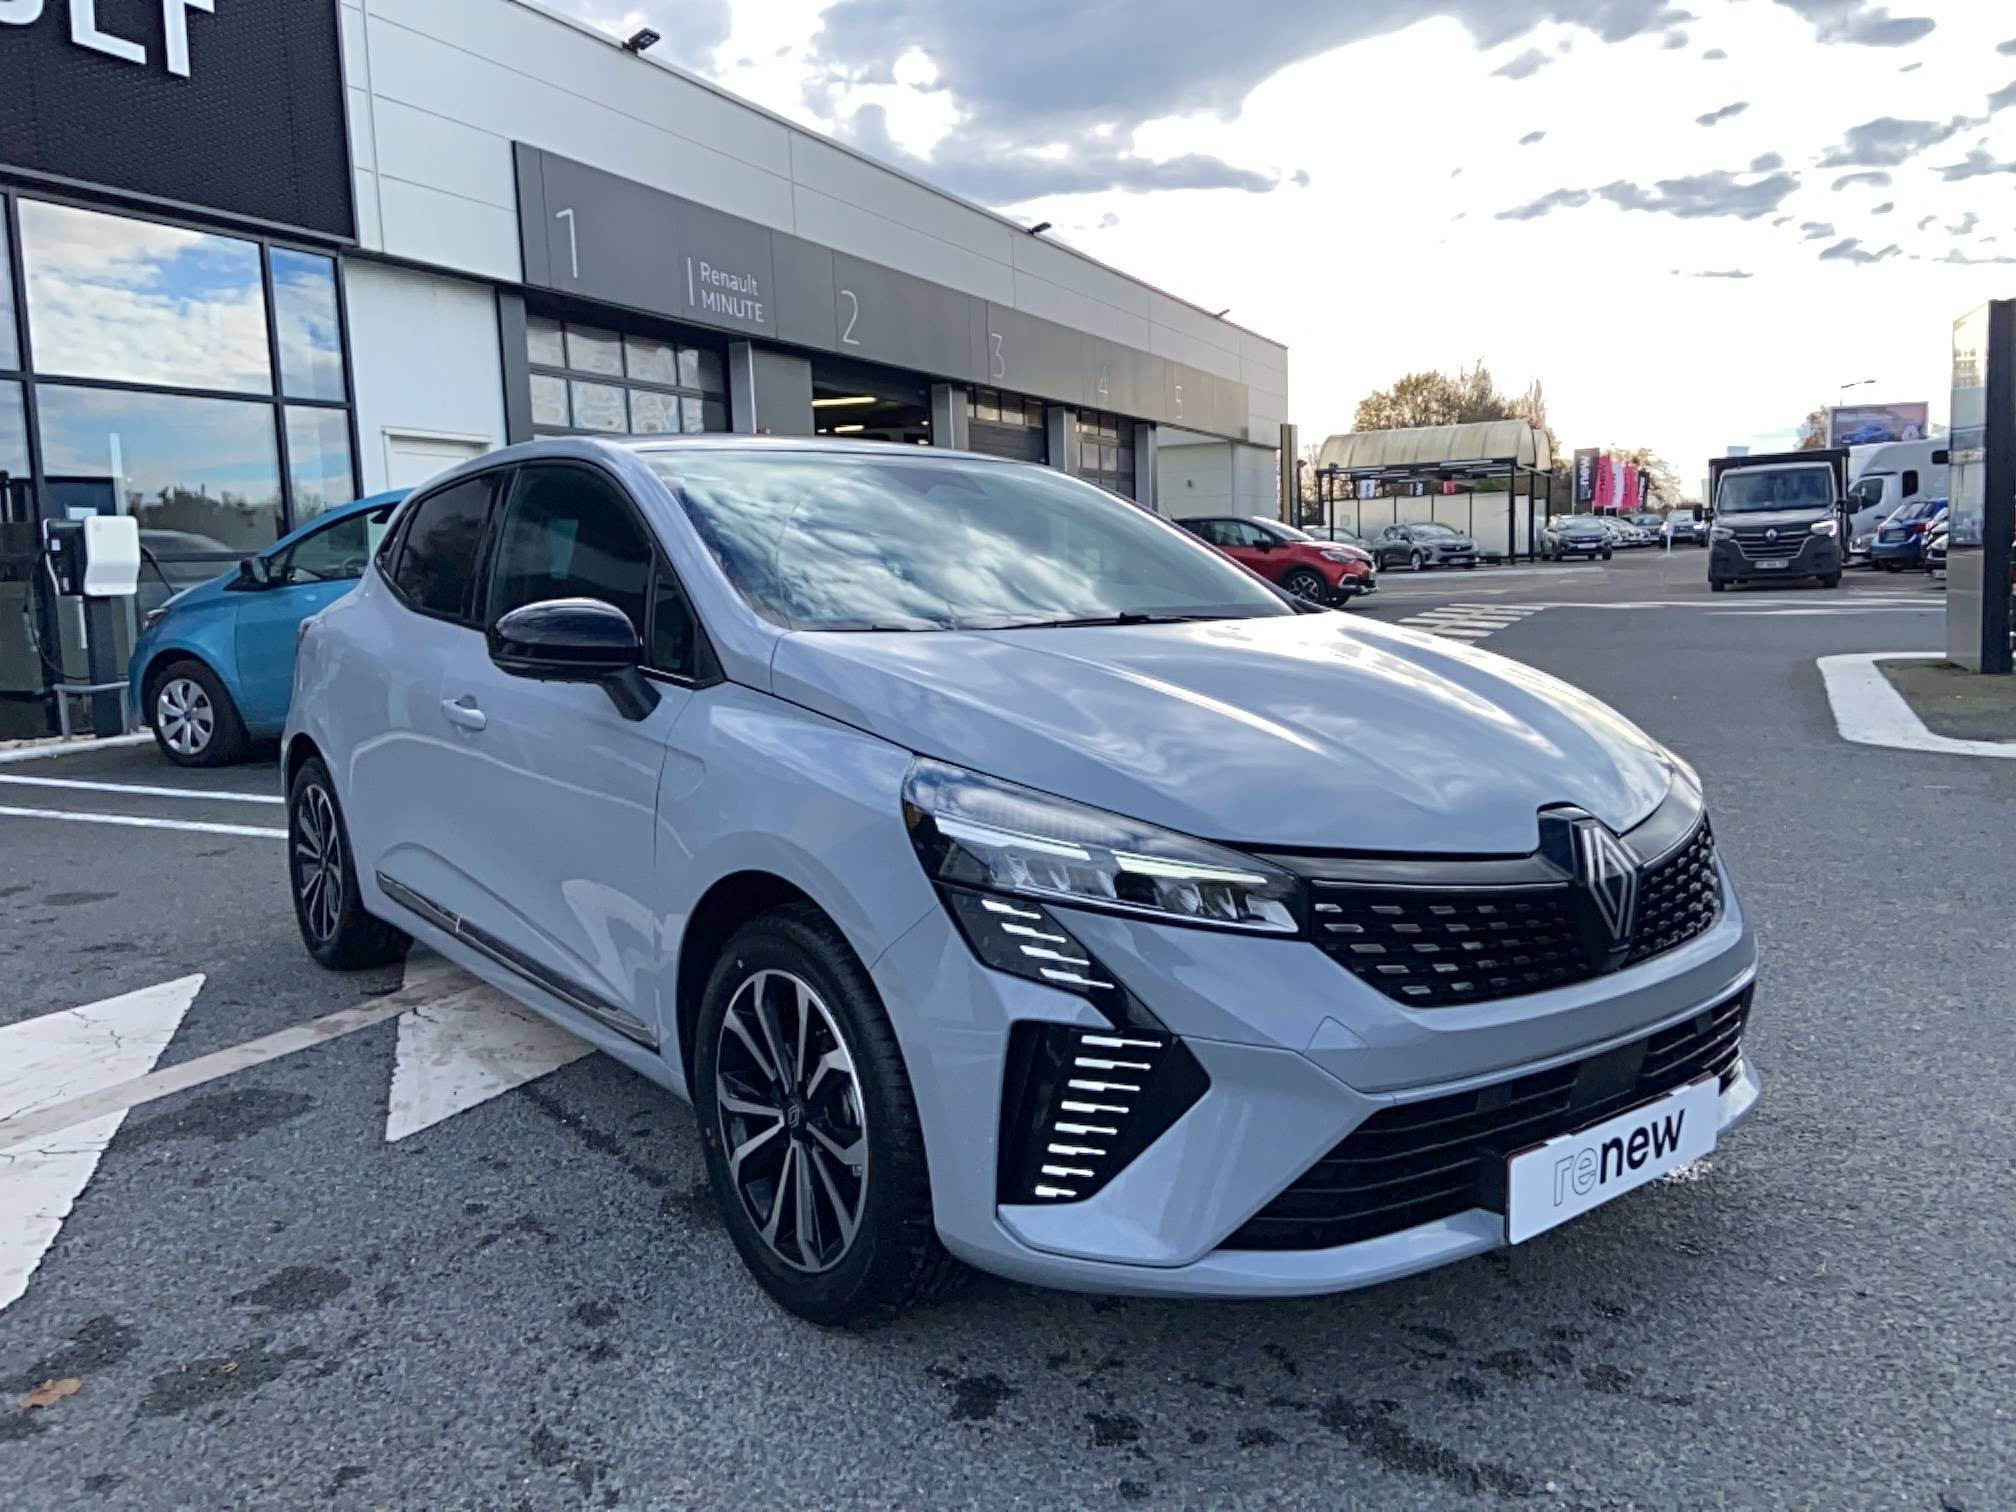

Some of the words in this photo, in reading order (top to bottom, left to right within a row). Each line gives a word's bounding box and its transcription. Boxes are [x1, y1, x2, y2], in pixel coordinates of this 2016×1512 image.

[555, 207, 578, 279] 1
[700, 260, 759, 296] Renault
[701, 289, 765, 323] MINUTE
[840, 289, 861, 345] 2
[991, 332, 1005, 379] 3
[1097, 365, 1109, 402] 4
[1553, 1108, 1686, 1207] renew
